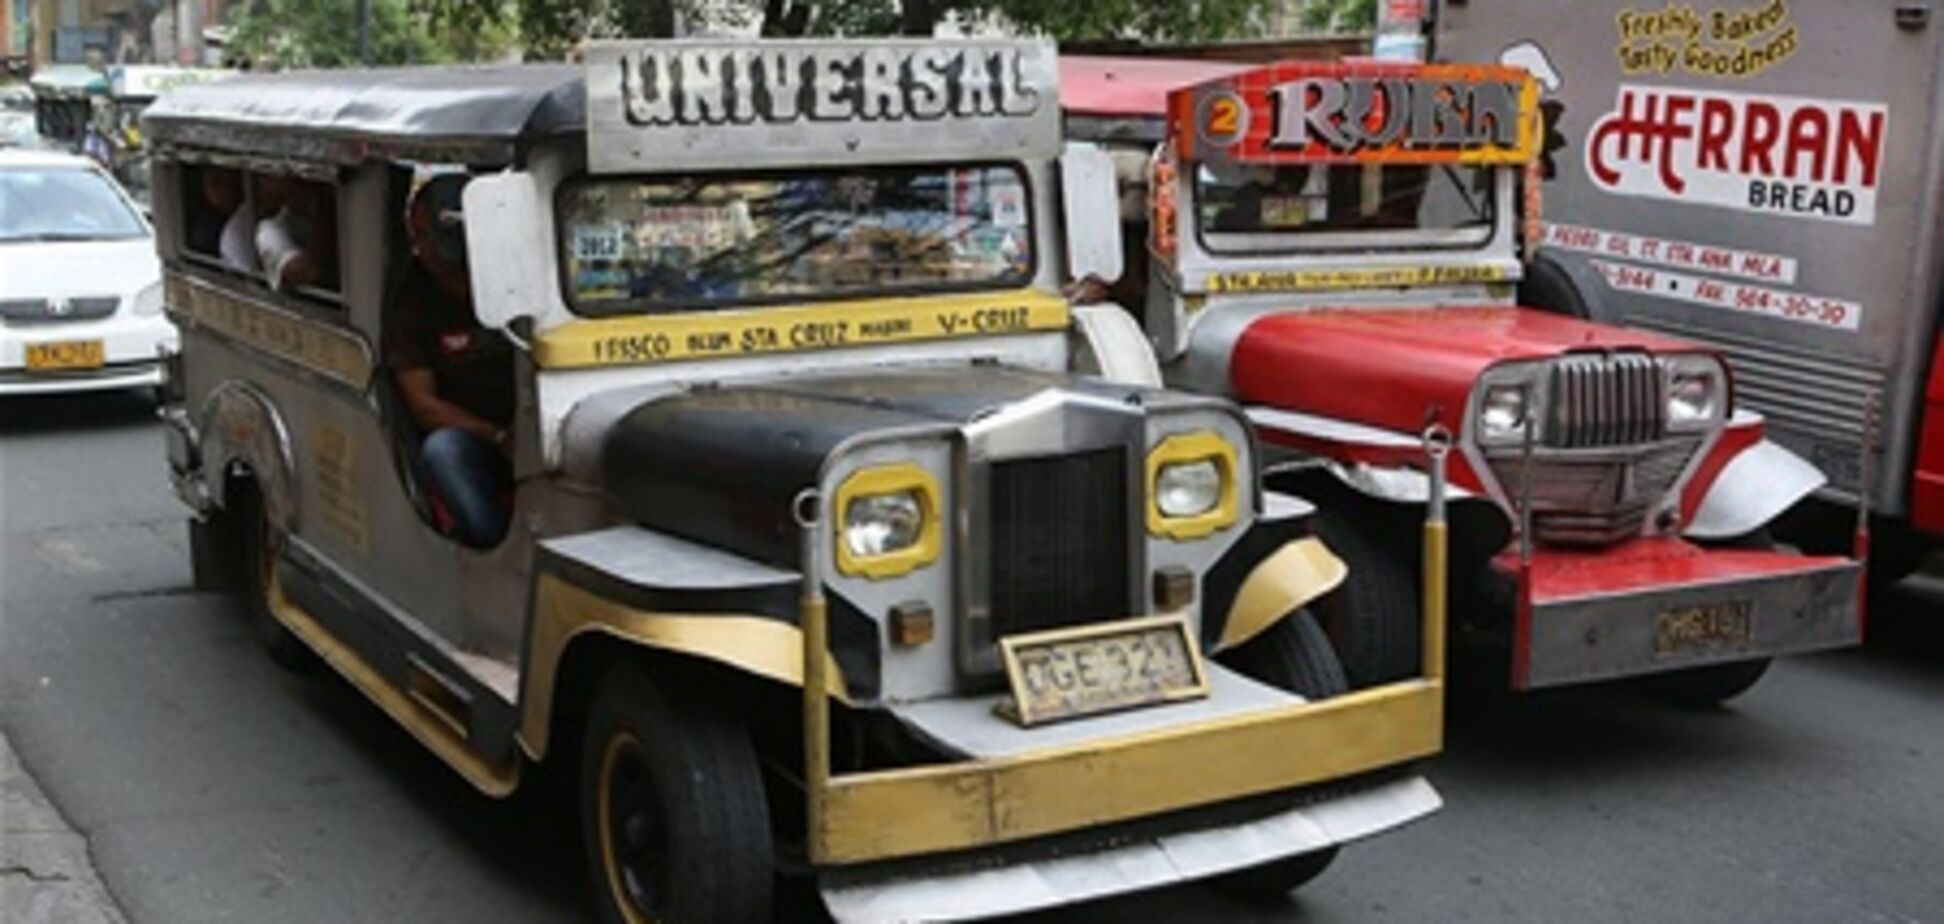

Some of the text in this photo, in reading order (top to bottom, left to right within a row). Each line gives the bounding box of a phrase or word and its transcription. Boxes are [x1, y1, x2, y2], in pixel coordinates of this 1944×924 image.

[1619, 0, 1785, 40] Freshly Baked
[1618, 27, 1796, 75] Tasty Goodness
[620, 48, 1039, 126] UNIVERSAL
[1210, 98, 1238, 134] 2
[1589, 91, 1885, 194] HERRAN
[1747, 180, 1856, 218] BREAD
[1741, 253, 1782, 278] MLA
[789, 320, 848, 347] CRUZ
[936, 306, 1029, 333] V-CRUZ
